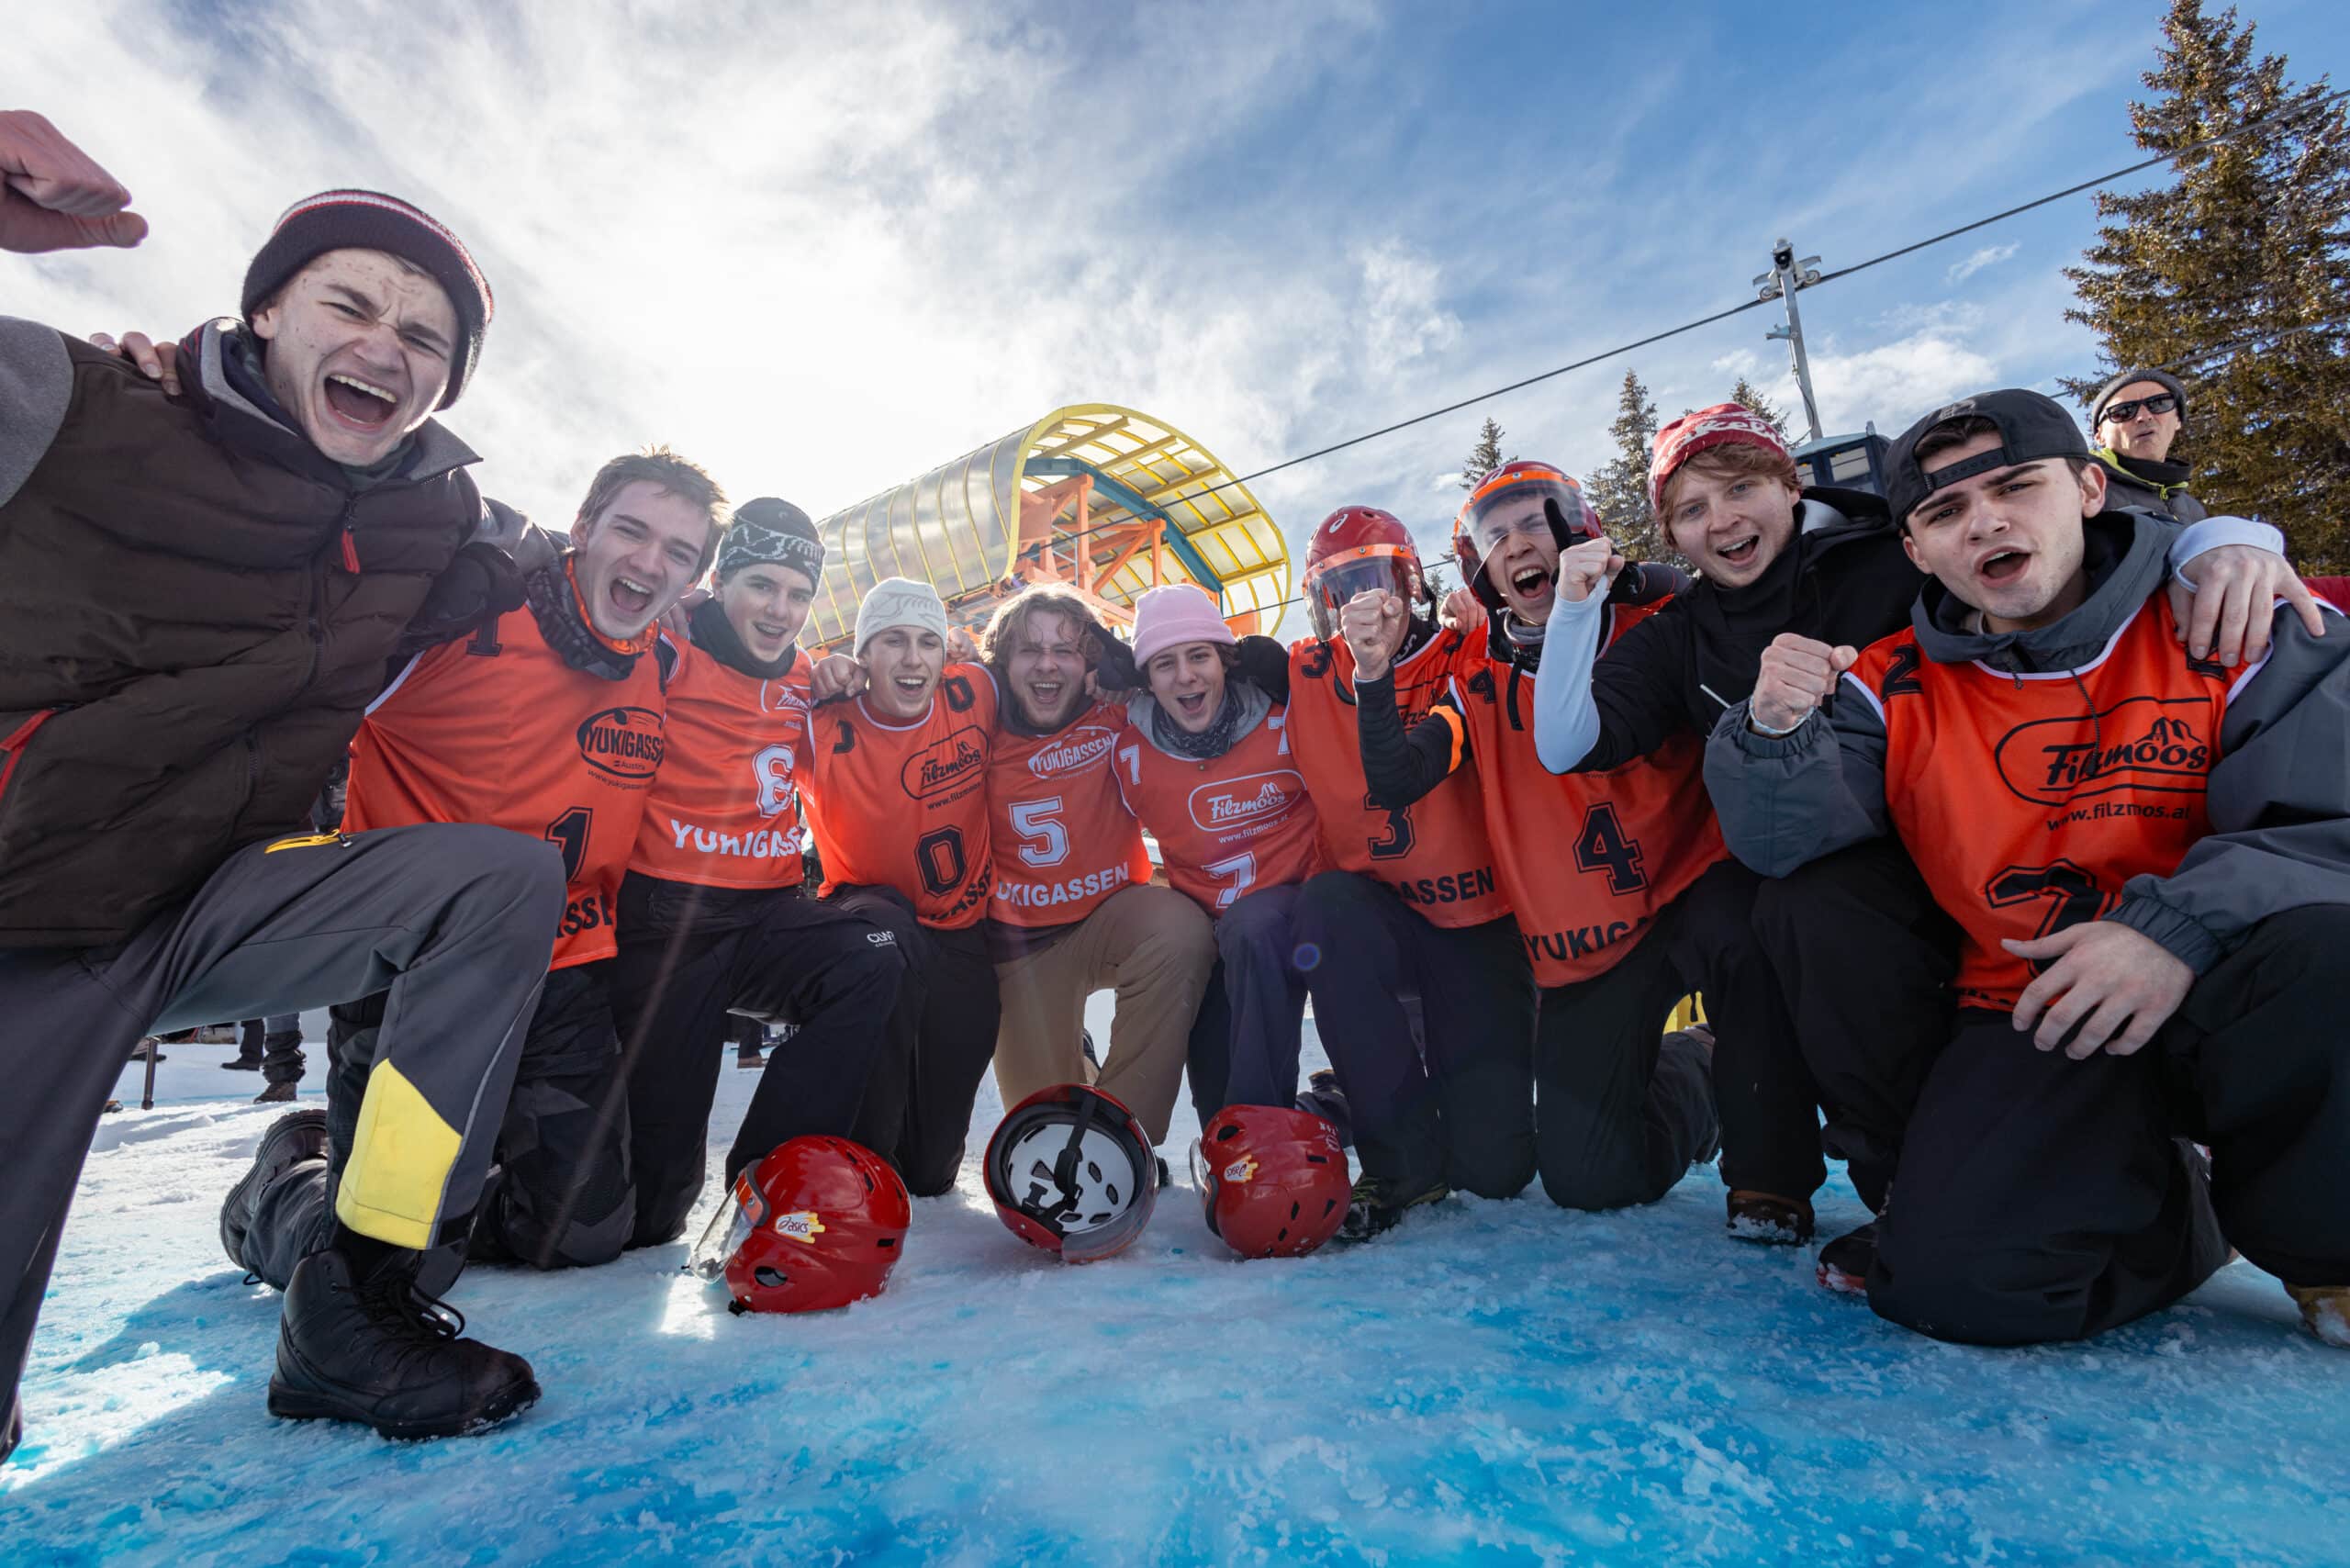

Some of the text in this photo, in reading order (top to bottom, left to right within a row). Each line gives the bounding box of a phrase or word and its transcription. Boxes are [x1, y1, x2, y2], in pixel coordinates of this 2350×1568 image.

[1301, 644, 1332, 678] 3
[1469, 667, 1497, 704] 4
[1880, 644, 1924, 704] 2
[945, 676, 975, 712] 0
[752, 744, 796, 819] 6
[1207, 790, 1286, 820] Filzmoos
[545, 806, 594, 883] 1
[1008, 795, 1070, 868] 5
[1364, 791, 1416, 861] 3
[1572, 801, 1650, 896] 4
[914, 823, 967, 899] 0
[1200, 851, 1257, 909] 7
[1393, 866, 1495, 905] ASSEN
[1524, 918, 1649, 962] YUKIG
